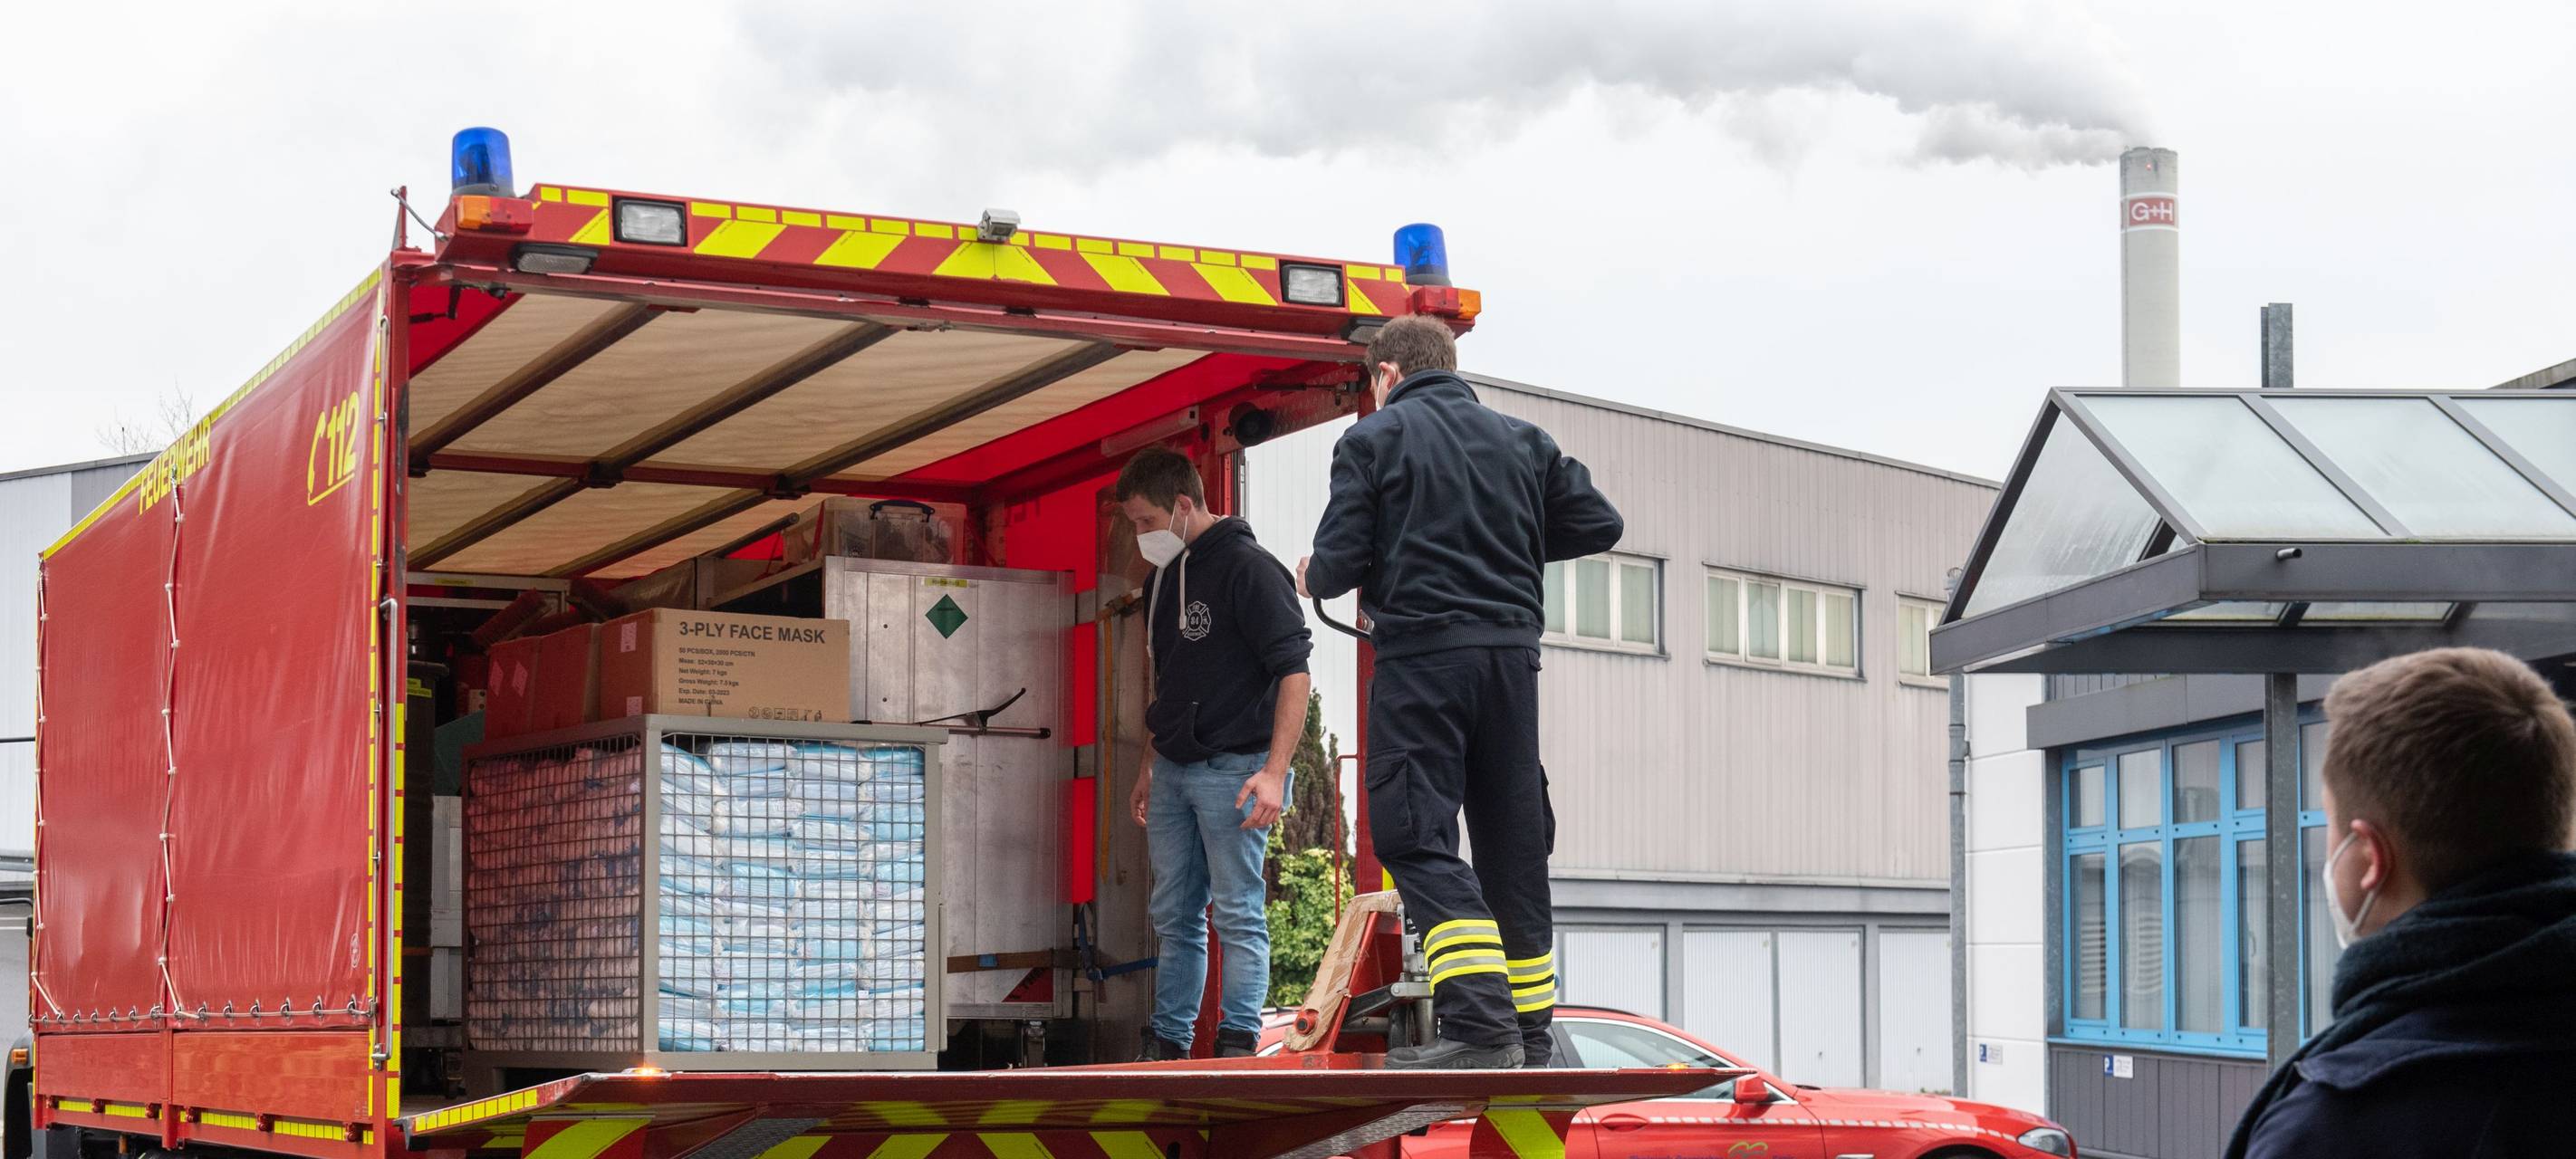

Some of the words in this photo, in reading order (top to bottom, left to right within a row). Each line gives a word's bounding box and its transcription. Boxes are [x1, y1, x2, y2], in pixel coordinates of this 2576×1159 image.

[2130, 201, 2174, 221] G+H
[326, 391, 360, 487] 112
[139, 416, 211, 516] FEUERWEHR
[679, 621, 726, 638] 3-PLY
[729, 624, 773, 640] FACE
[778, 627, 825, 644] MASK
[697, 678, 718, 686] Weight:
